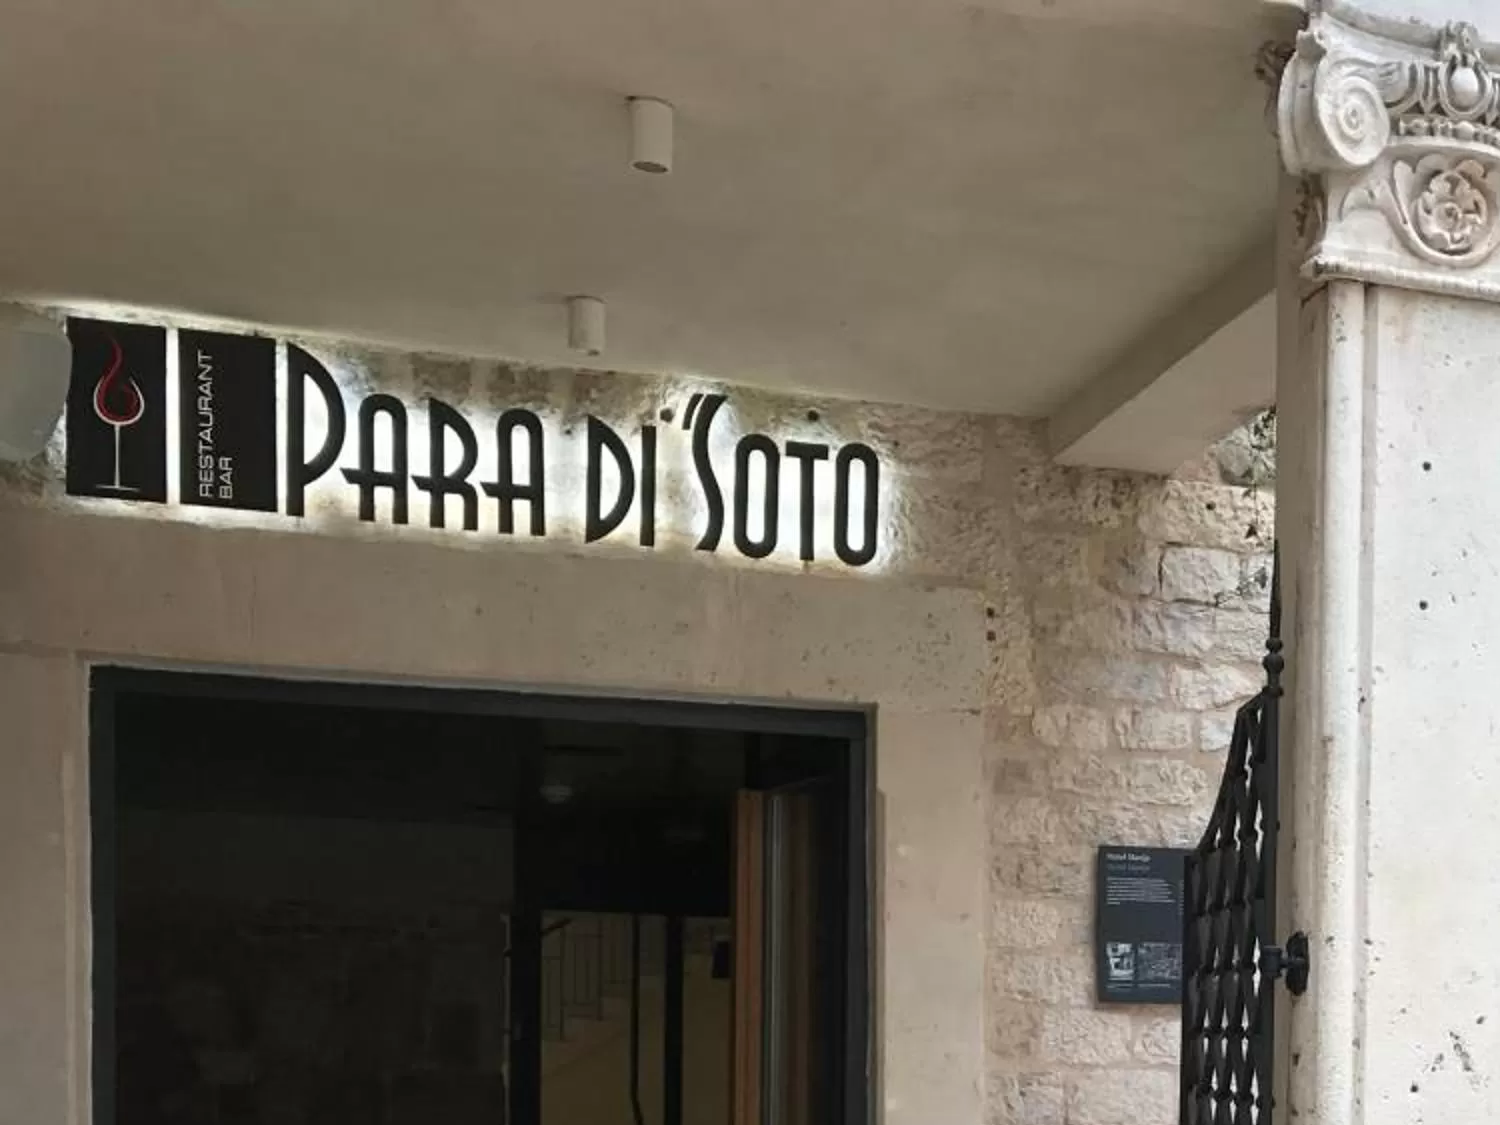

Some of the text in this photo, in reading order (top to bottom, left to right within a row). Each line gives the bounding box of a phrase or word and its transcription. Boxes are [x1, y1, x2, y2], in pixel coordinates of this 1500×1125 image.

[198, 349, 214, 498] RESTAURANT
[219, 456, 233, 499] BAR
[286, 341, 546, 536] PARA
